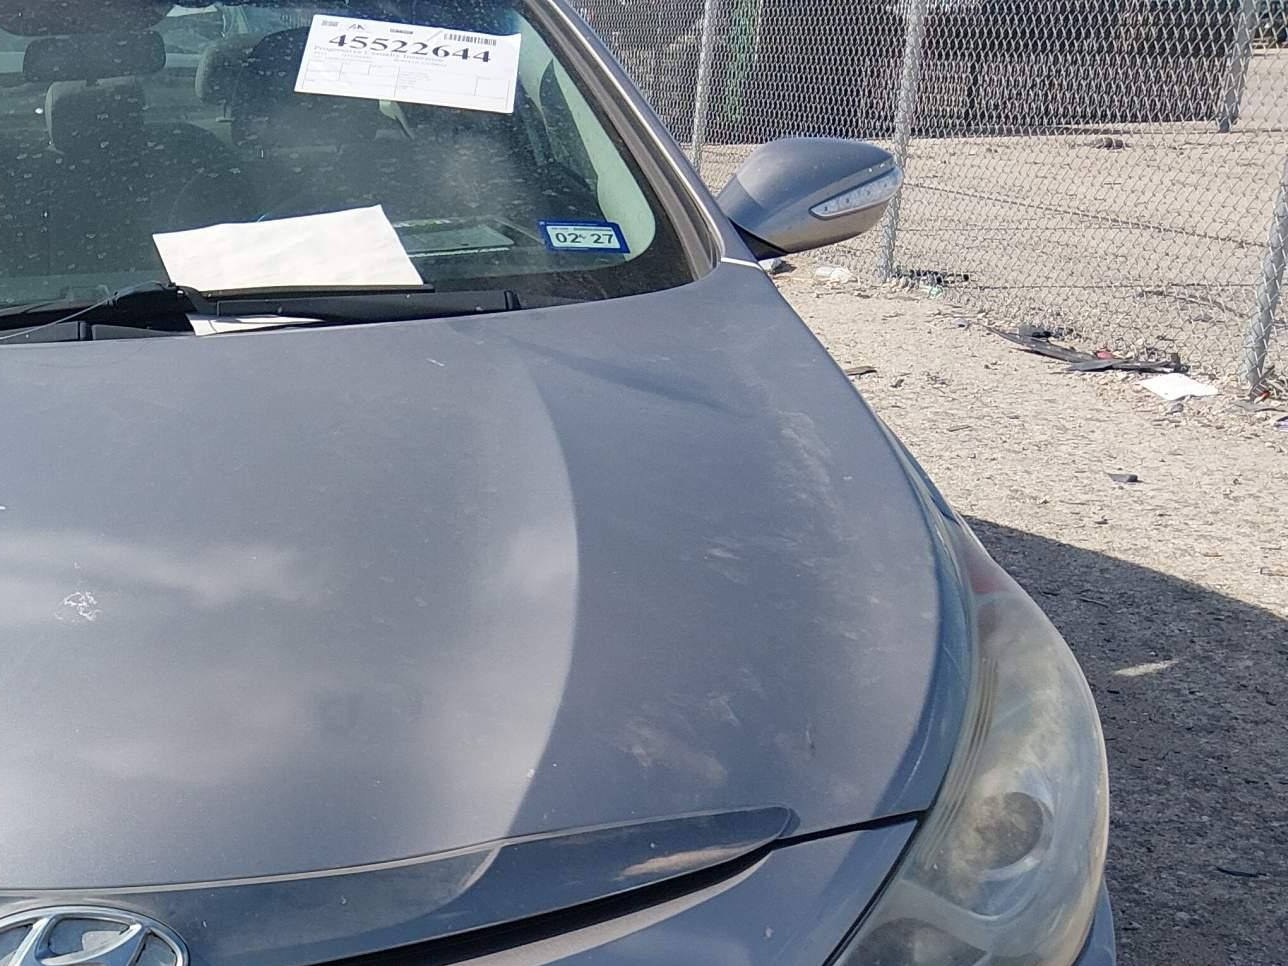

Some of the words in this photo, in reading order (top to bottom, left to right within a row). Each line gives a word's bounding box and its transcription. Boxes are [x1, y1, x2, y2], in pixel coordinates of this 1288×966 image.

[329, 34, 491, 63] 45522644
[555, 232, 581, 243] 02
[590, 233, 613, 244] 27
